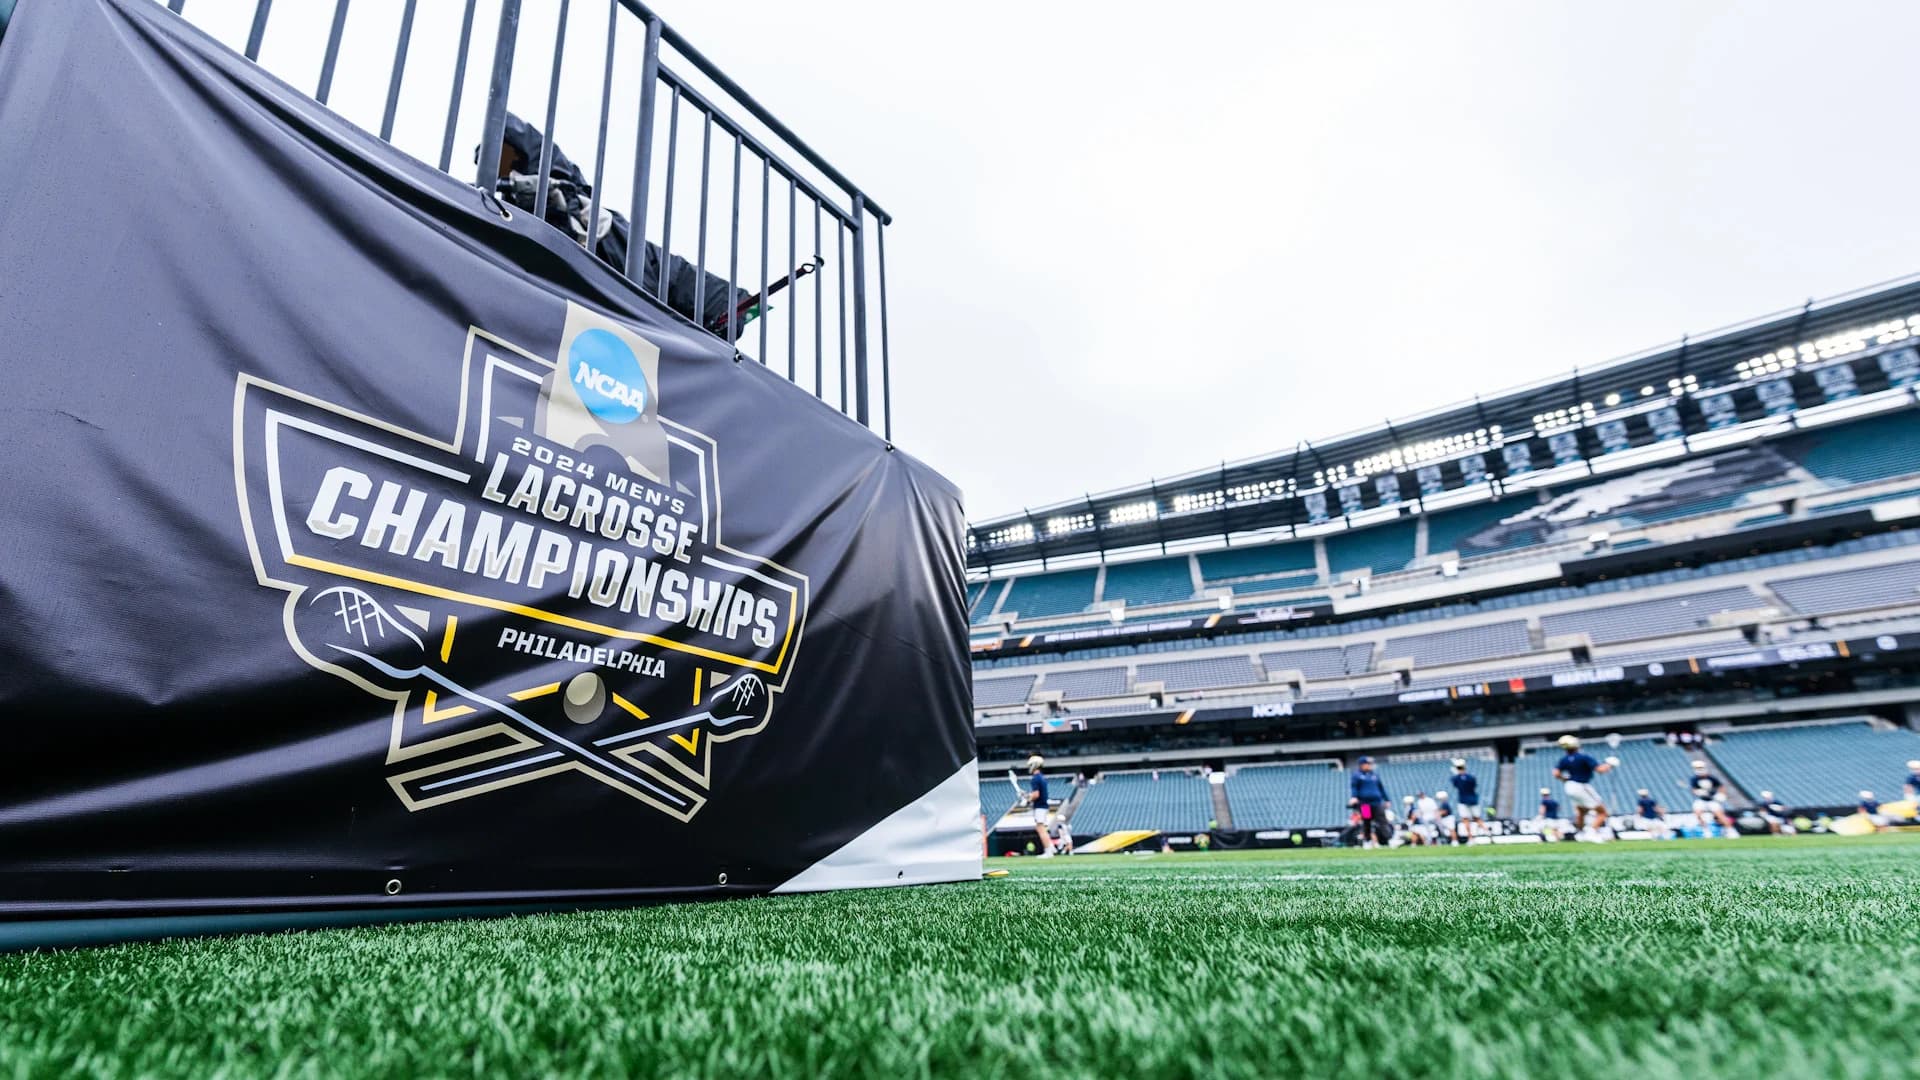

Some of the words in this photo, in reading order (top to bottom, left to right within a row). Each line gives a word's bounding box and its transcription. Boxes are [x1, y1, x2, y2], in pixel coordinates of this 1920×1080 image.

[574, 360, 643, 414] NCAA
[481, 452, 699, 564] LACROSSE
[512, 437, 595, 480] 2024
[605, 472, 686, 515] MEN'S
[305, 466, 778, 648] CHAMPIONSHIPS
[497, 627, 666, 679] PHILADELPHIA
